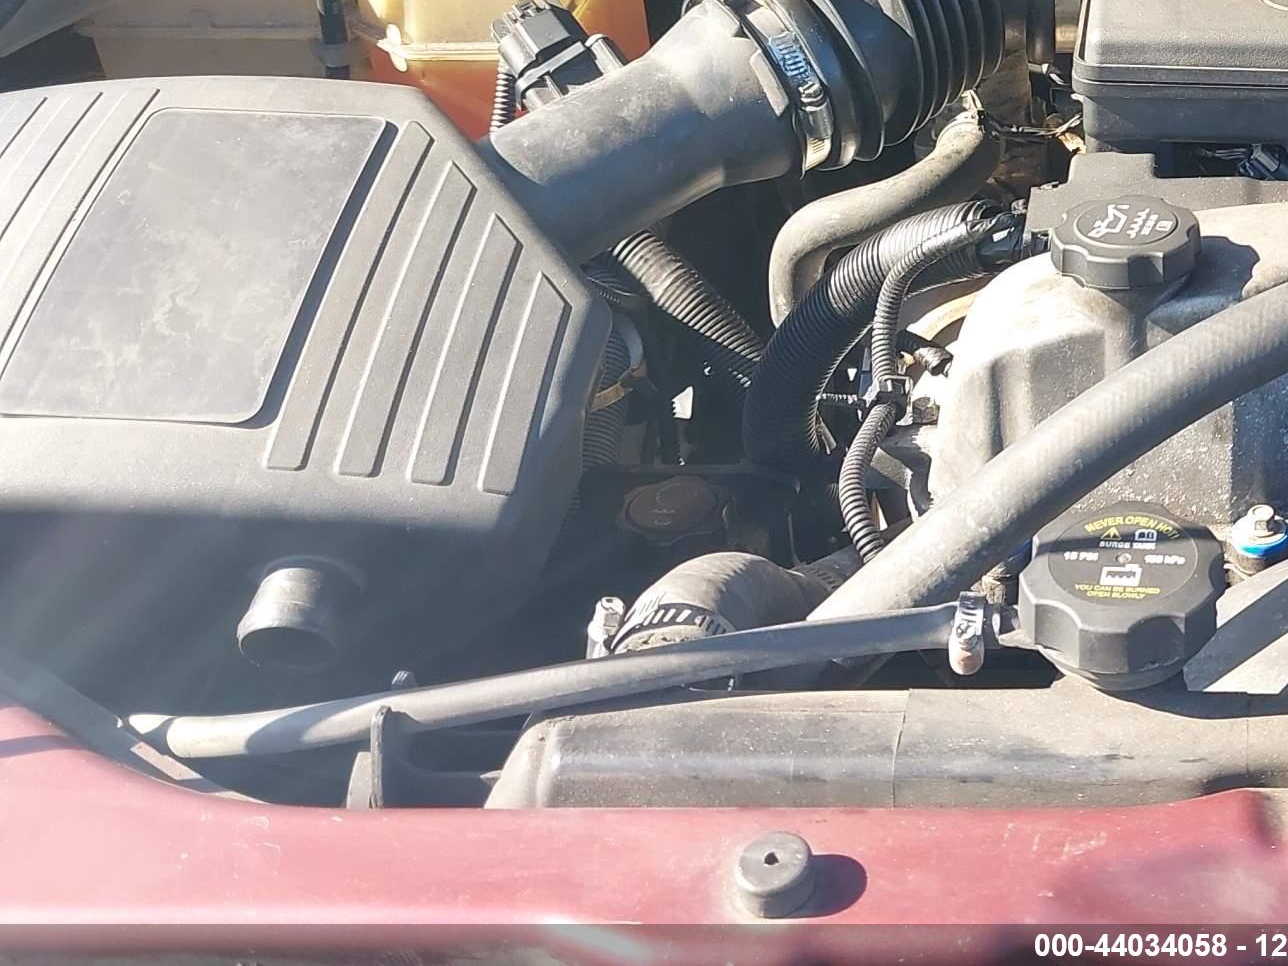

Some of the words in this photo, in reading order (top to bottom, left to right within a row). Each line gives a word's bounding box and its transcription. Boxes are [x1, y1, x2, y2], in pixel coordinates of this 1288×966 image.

[1084, 517, 1124, 533] NEVER
[1124, 515, 1155, 530] OPEN
[1074, 583, 1093, 591] YOU
